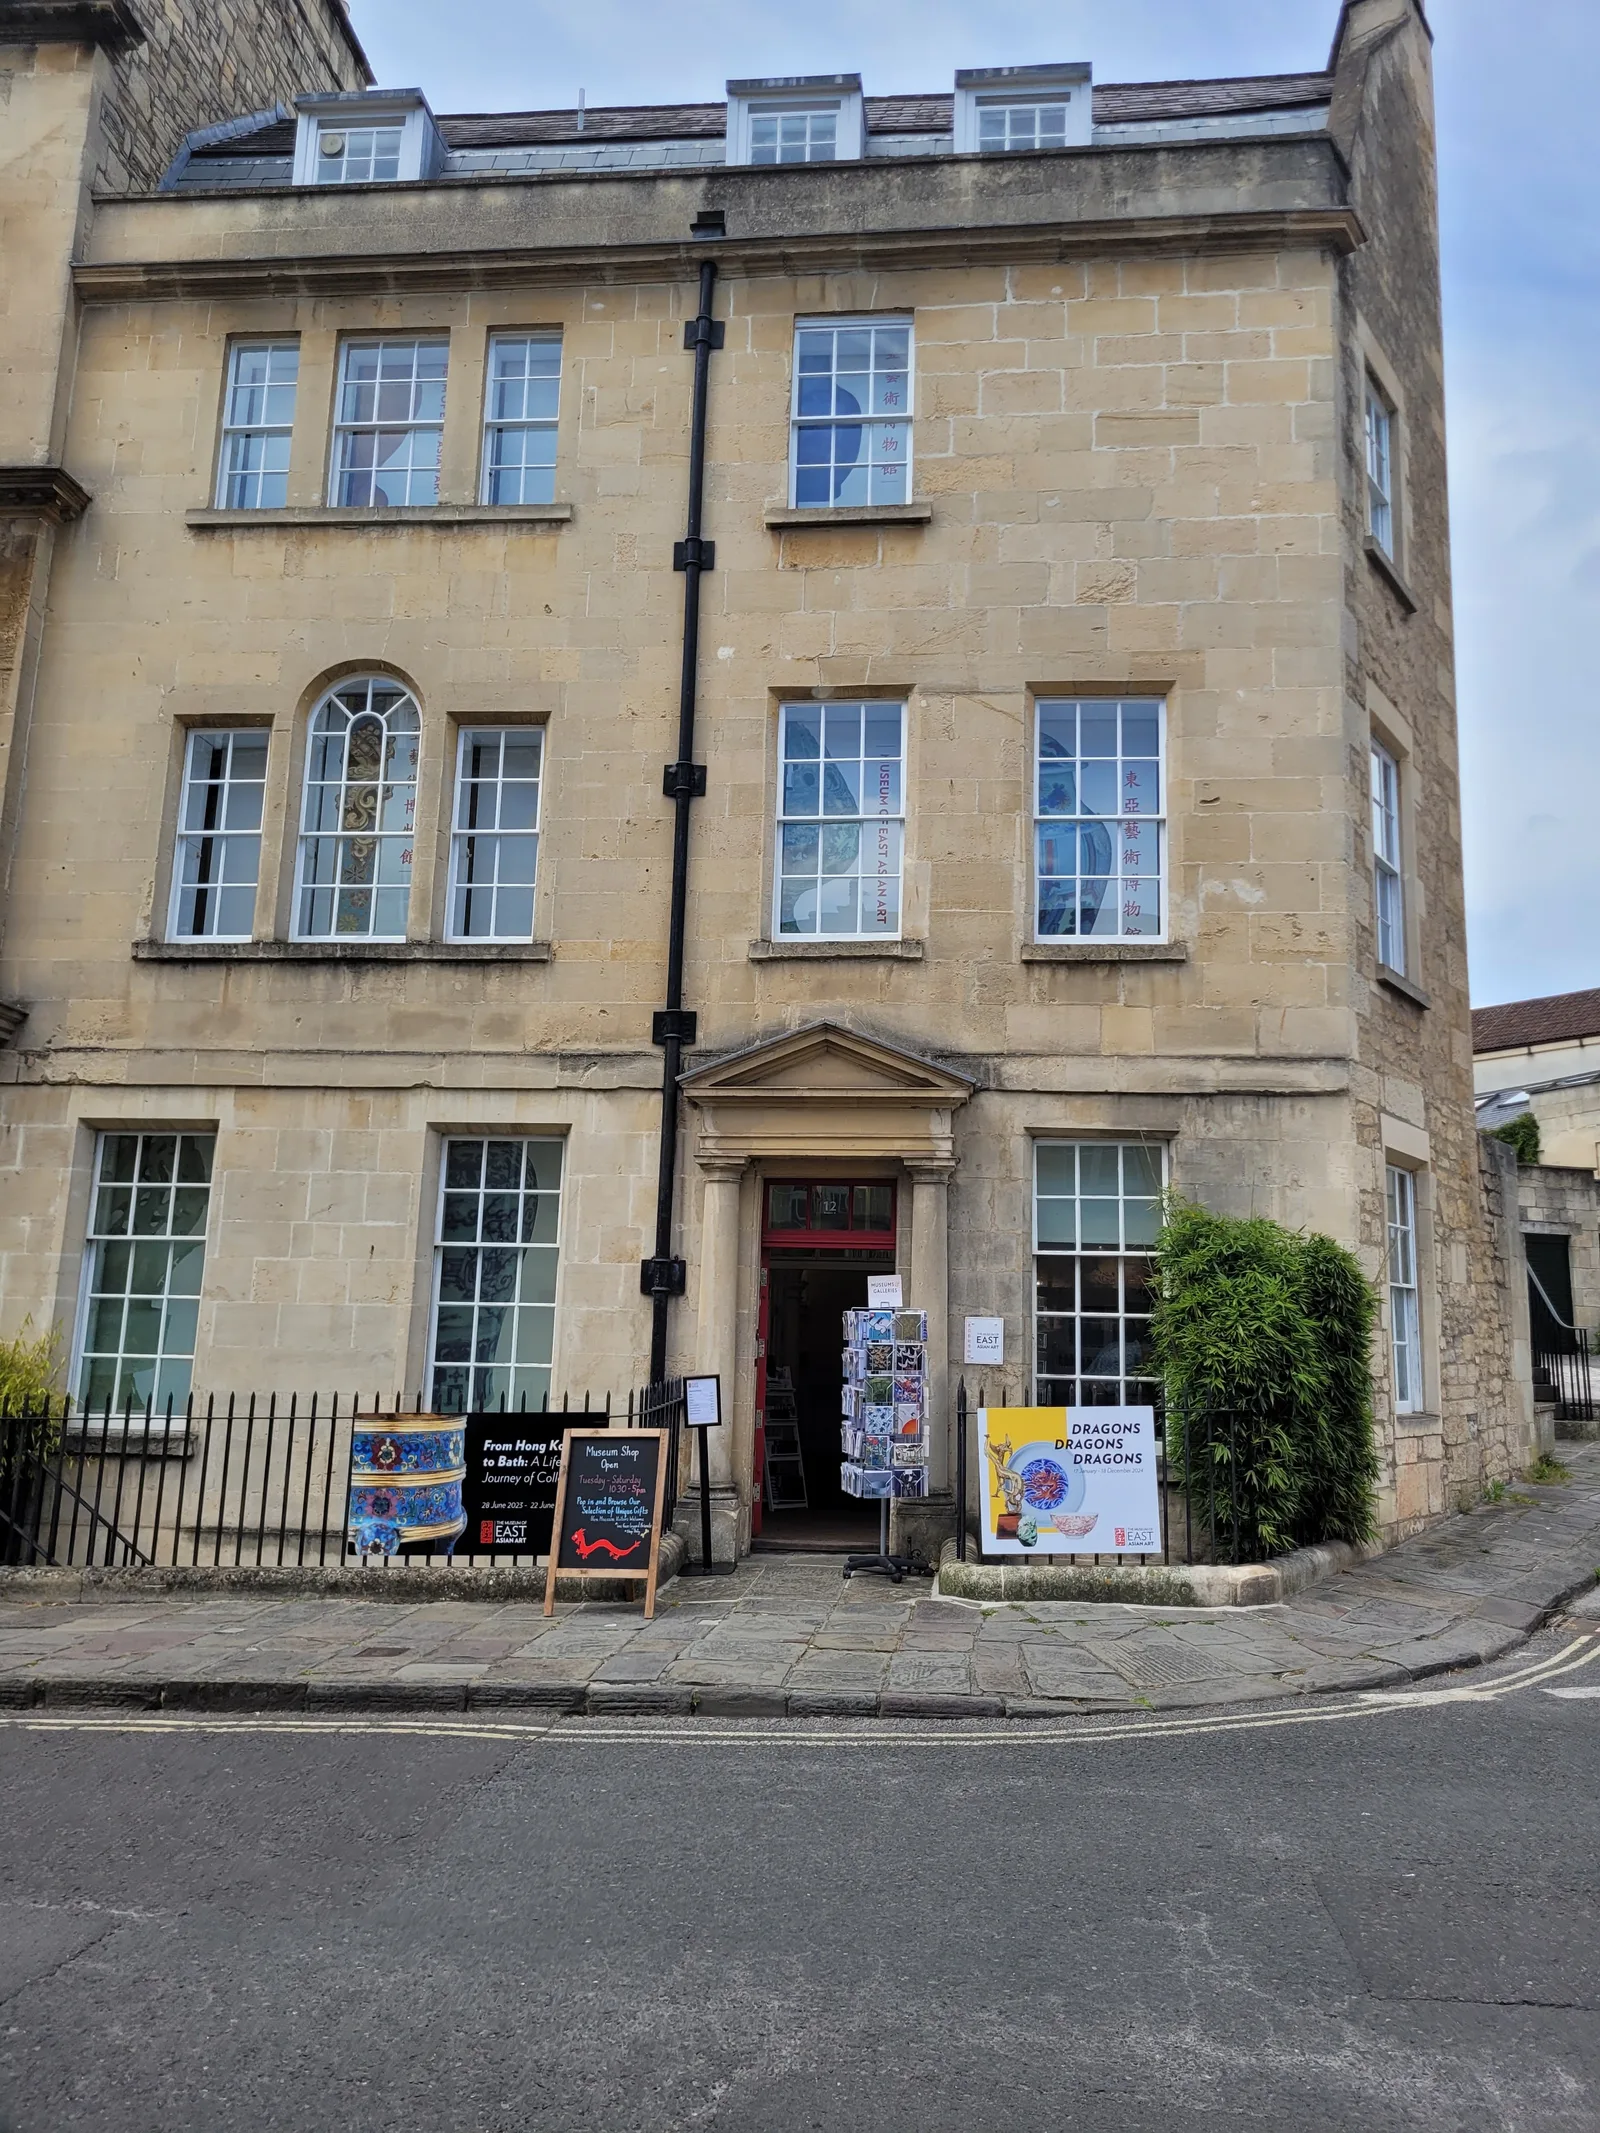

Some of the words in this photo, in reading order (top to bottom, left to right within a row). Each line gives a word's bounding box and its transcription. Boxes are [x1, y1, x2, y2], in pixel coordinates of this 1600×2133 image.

[878, 828, 888, 857] EAST
[877, 860, 887, 896] ASAN
[876, 900, 886, 924] ART
[824, 1201, 836, 1211] 12
[976, 1336, 999, 1344] EAST
[1072, 1423, 1140, 1434] DRAGONS
[484, 1440, 512, 1450] From
[515, 1440, 546, 1453] Hong
[1055, 1438, 1123, 1450] DRAGONS
[586, 1446, 618, 1456] Museum
[621, 1445, 639, 1461] Shop
[1074, 1453, 1142, 1464] DRAGONS
[483, 1458, 495, 1466] to
[498, 1456, 528, 1466] Bath:
[531, 1456, 539, 1466] A
[601, 1459, 618, 1472] Open
[482, 1472, 521, 1486] Journey
[524, 1472, 535, 1486] of
[537, 1471, 559, 1482] Coll
[579, 1474, 605, 1491] Tuesday
[612, 1474, 641, 1487] Saturday
[577, 1497, 586, 1507] Pop
[596, 1497, 606, 1505] and
[608, 1497, 627, 1505] Browse
[629, 1497, 640, 1505] Our
[582, 1506, 606, 1514] Selection
[607, 1506, 614, 1517] of
[616, 1506, 633, 1518] Unique
[634, 1506, 648, 1516] Gifts
[496, 1526, 527, 1537] EAST
[1128, 1532, 1154, 1541] EAST
